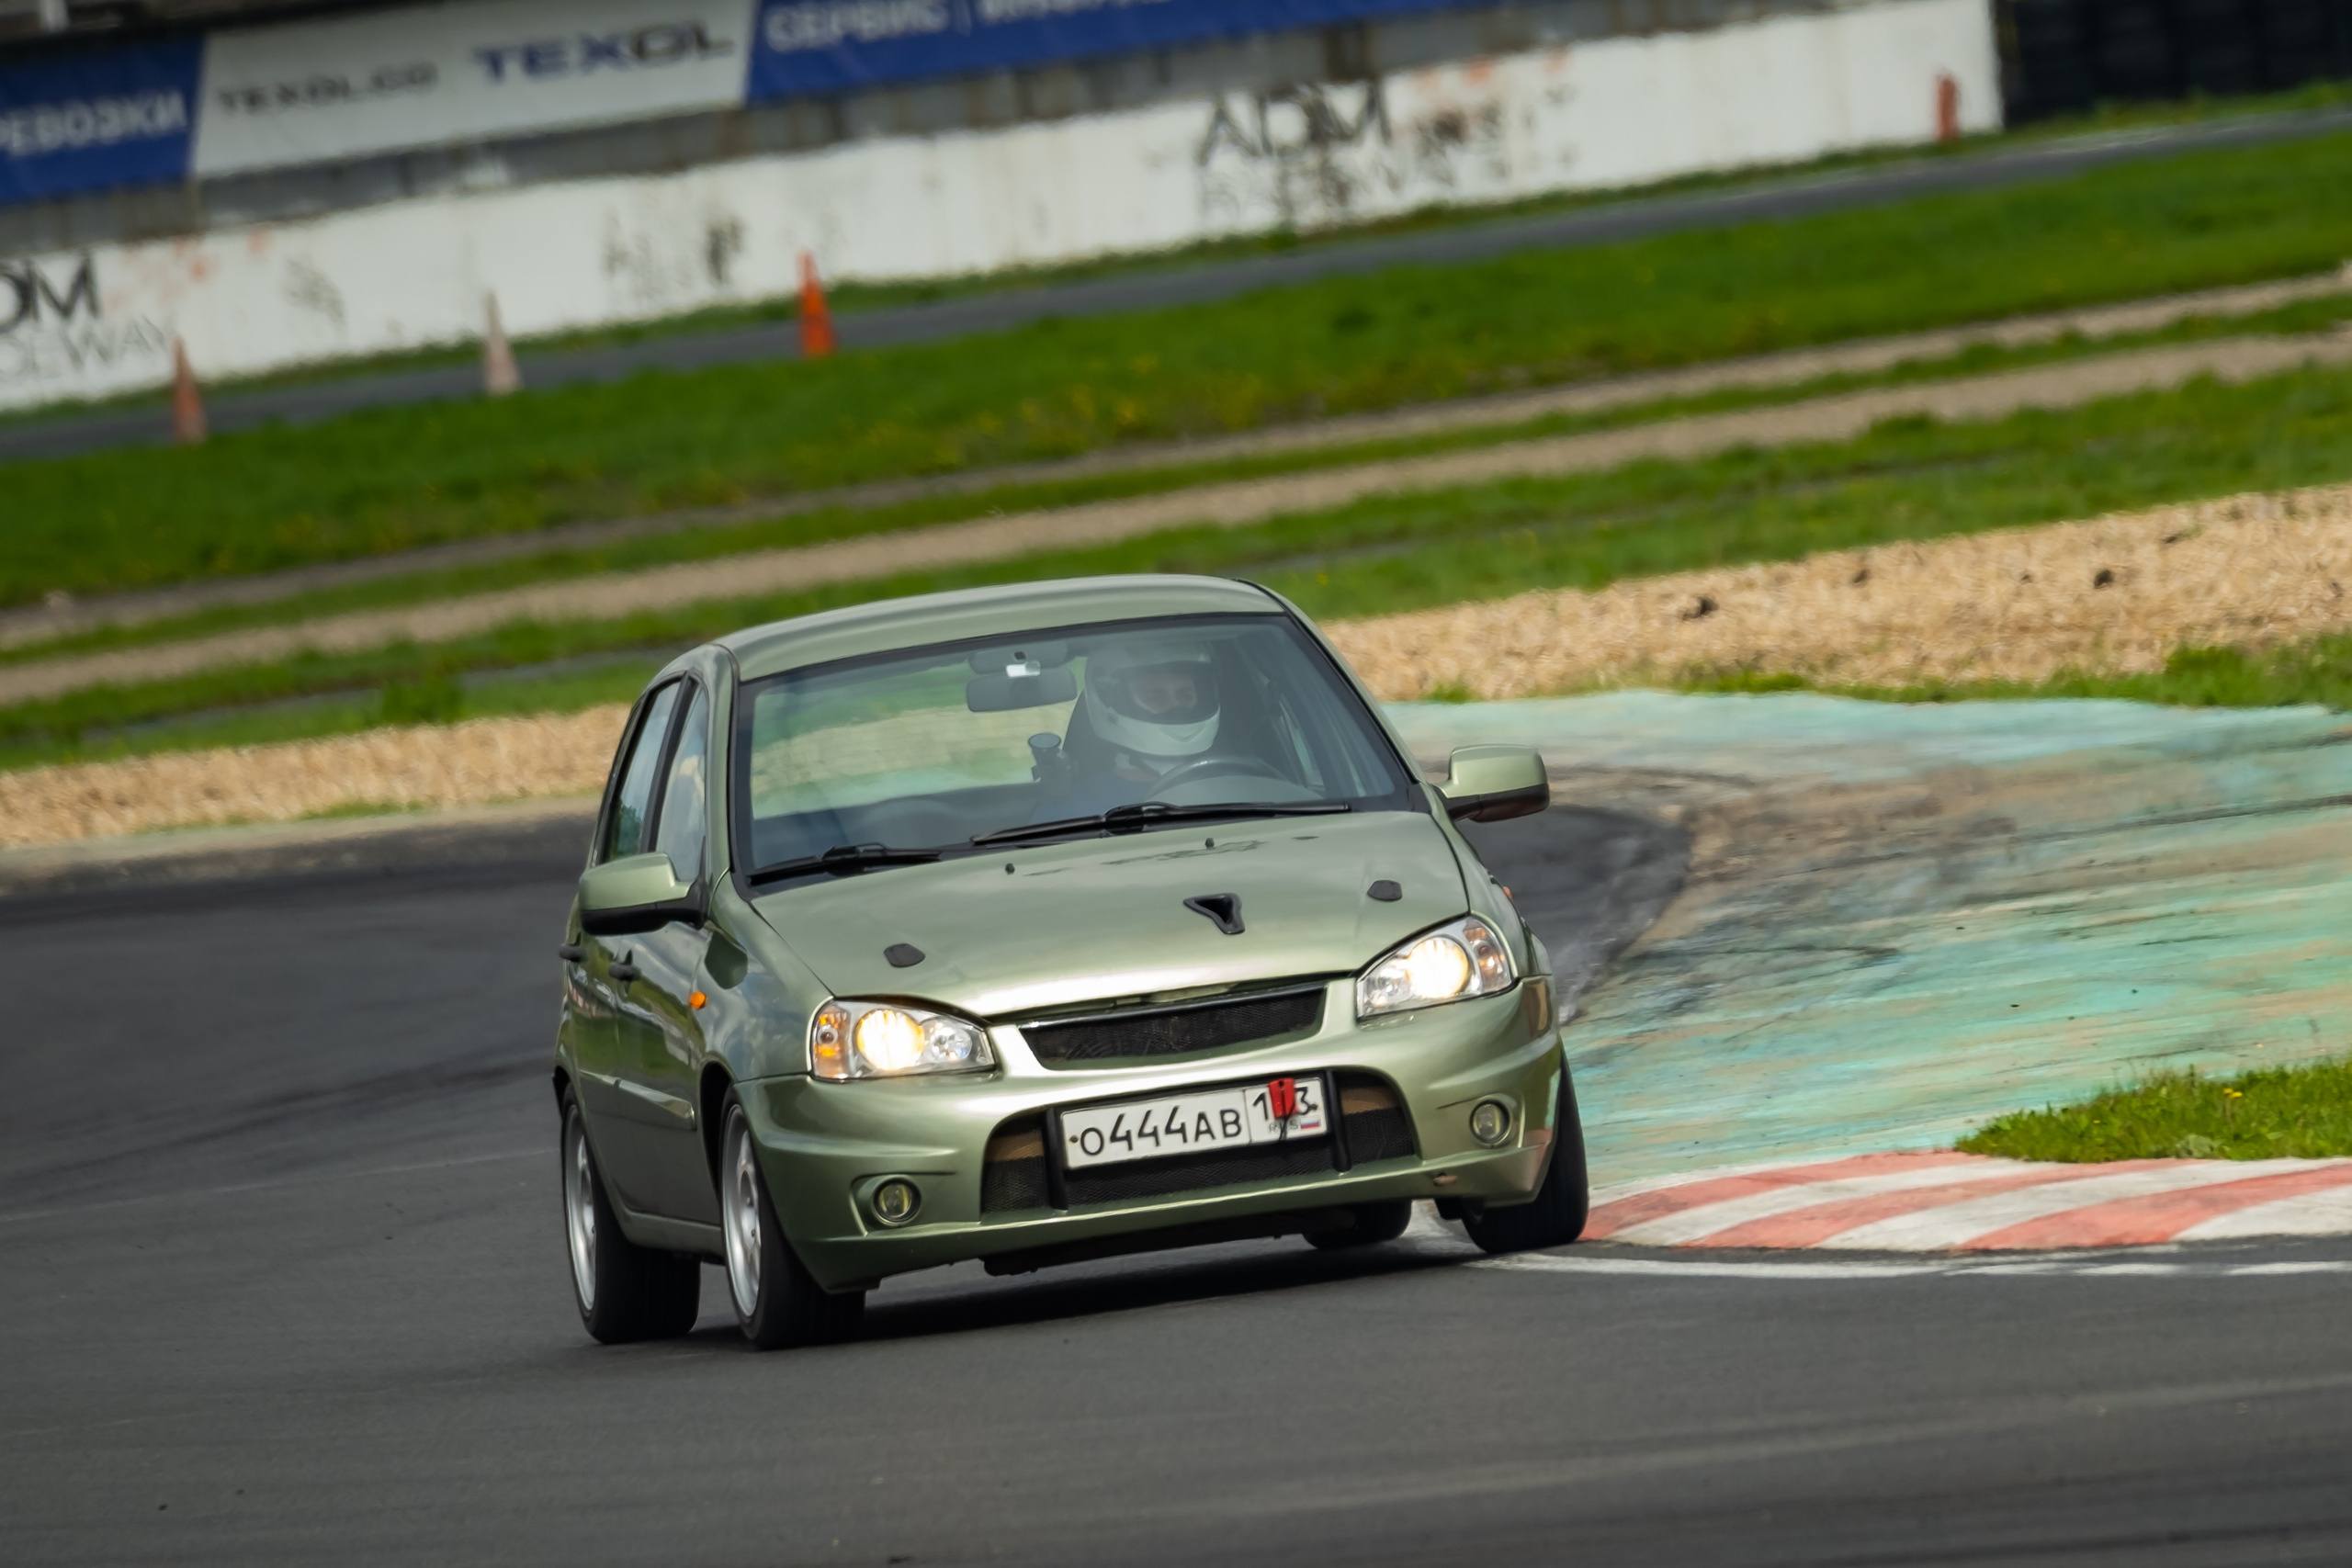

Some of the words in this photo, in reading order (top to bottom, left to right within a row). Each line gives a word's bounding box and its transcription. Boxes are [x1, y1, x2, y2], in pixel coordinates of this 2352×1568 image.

[473, 20, 734, 84] TEXOL
[0, 90, 187, 156] ЕВОЗКИ
[1252, 1086, 1309, 1121] 13
